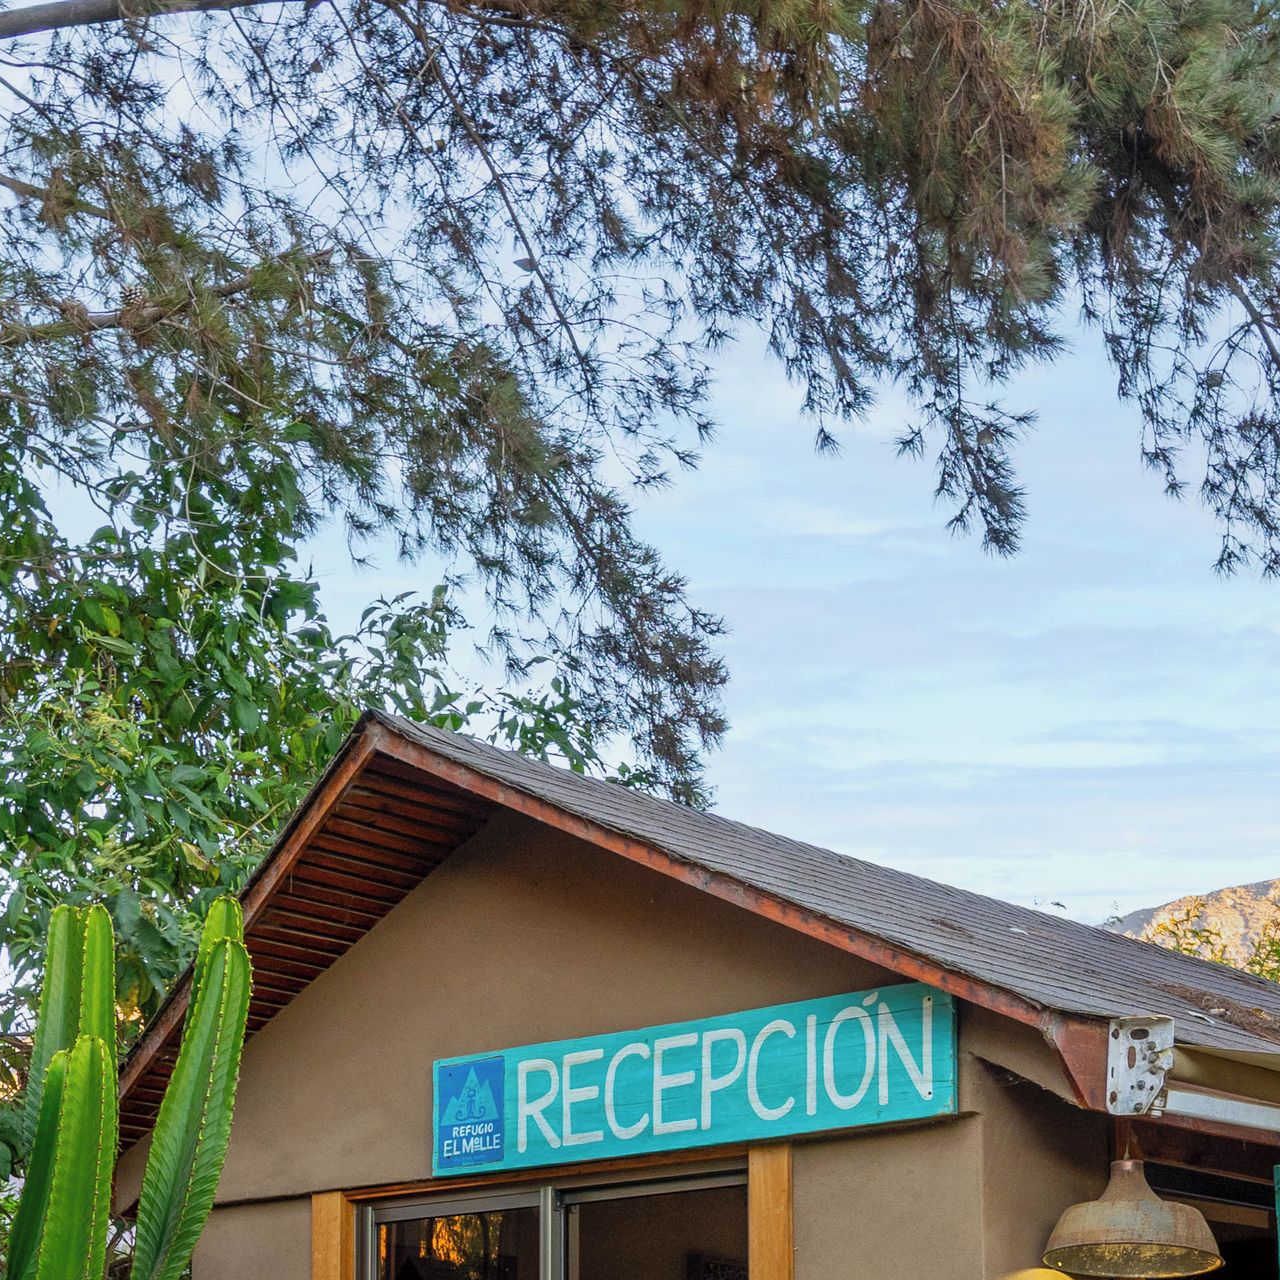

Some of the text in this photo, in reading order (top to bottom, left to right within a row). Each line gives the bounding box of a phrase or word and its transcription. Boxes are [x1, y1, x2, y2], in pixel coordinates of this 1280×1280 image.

[517, 991, 933, 1153] RECEPCIÓN
[452, 1122, 494, 1138] REFUGIO
[443, 1133, 502, 1157] EL MOLLE
